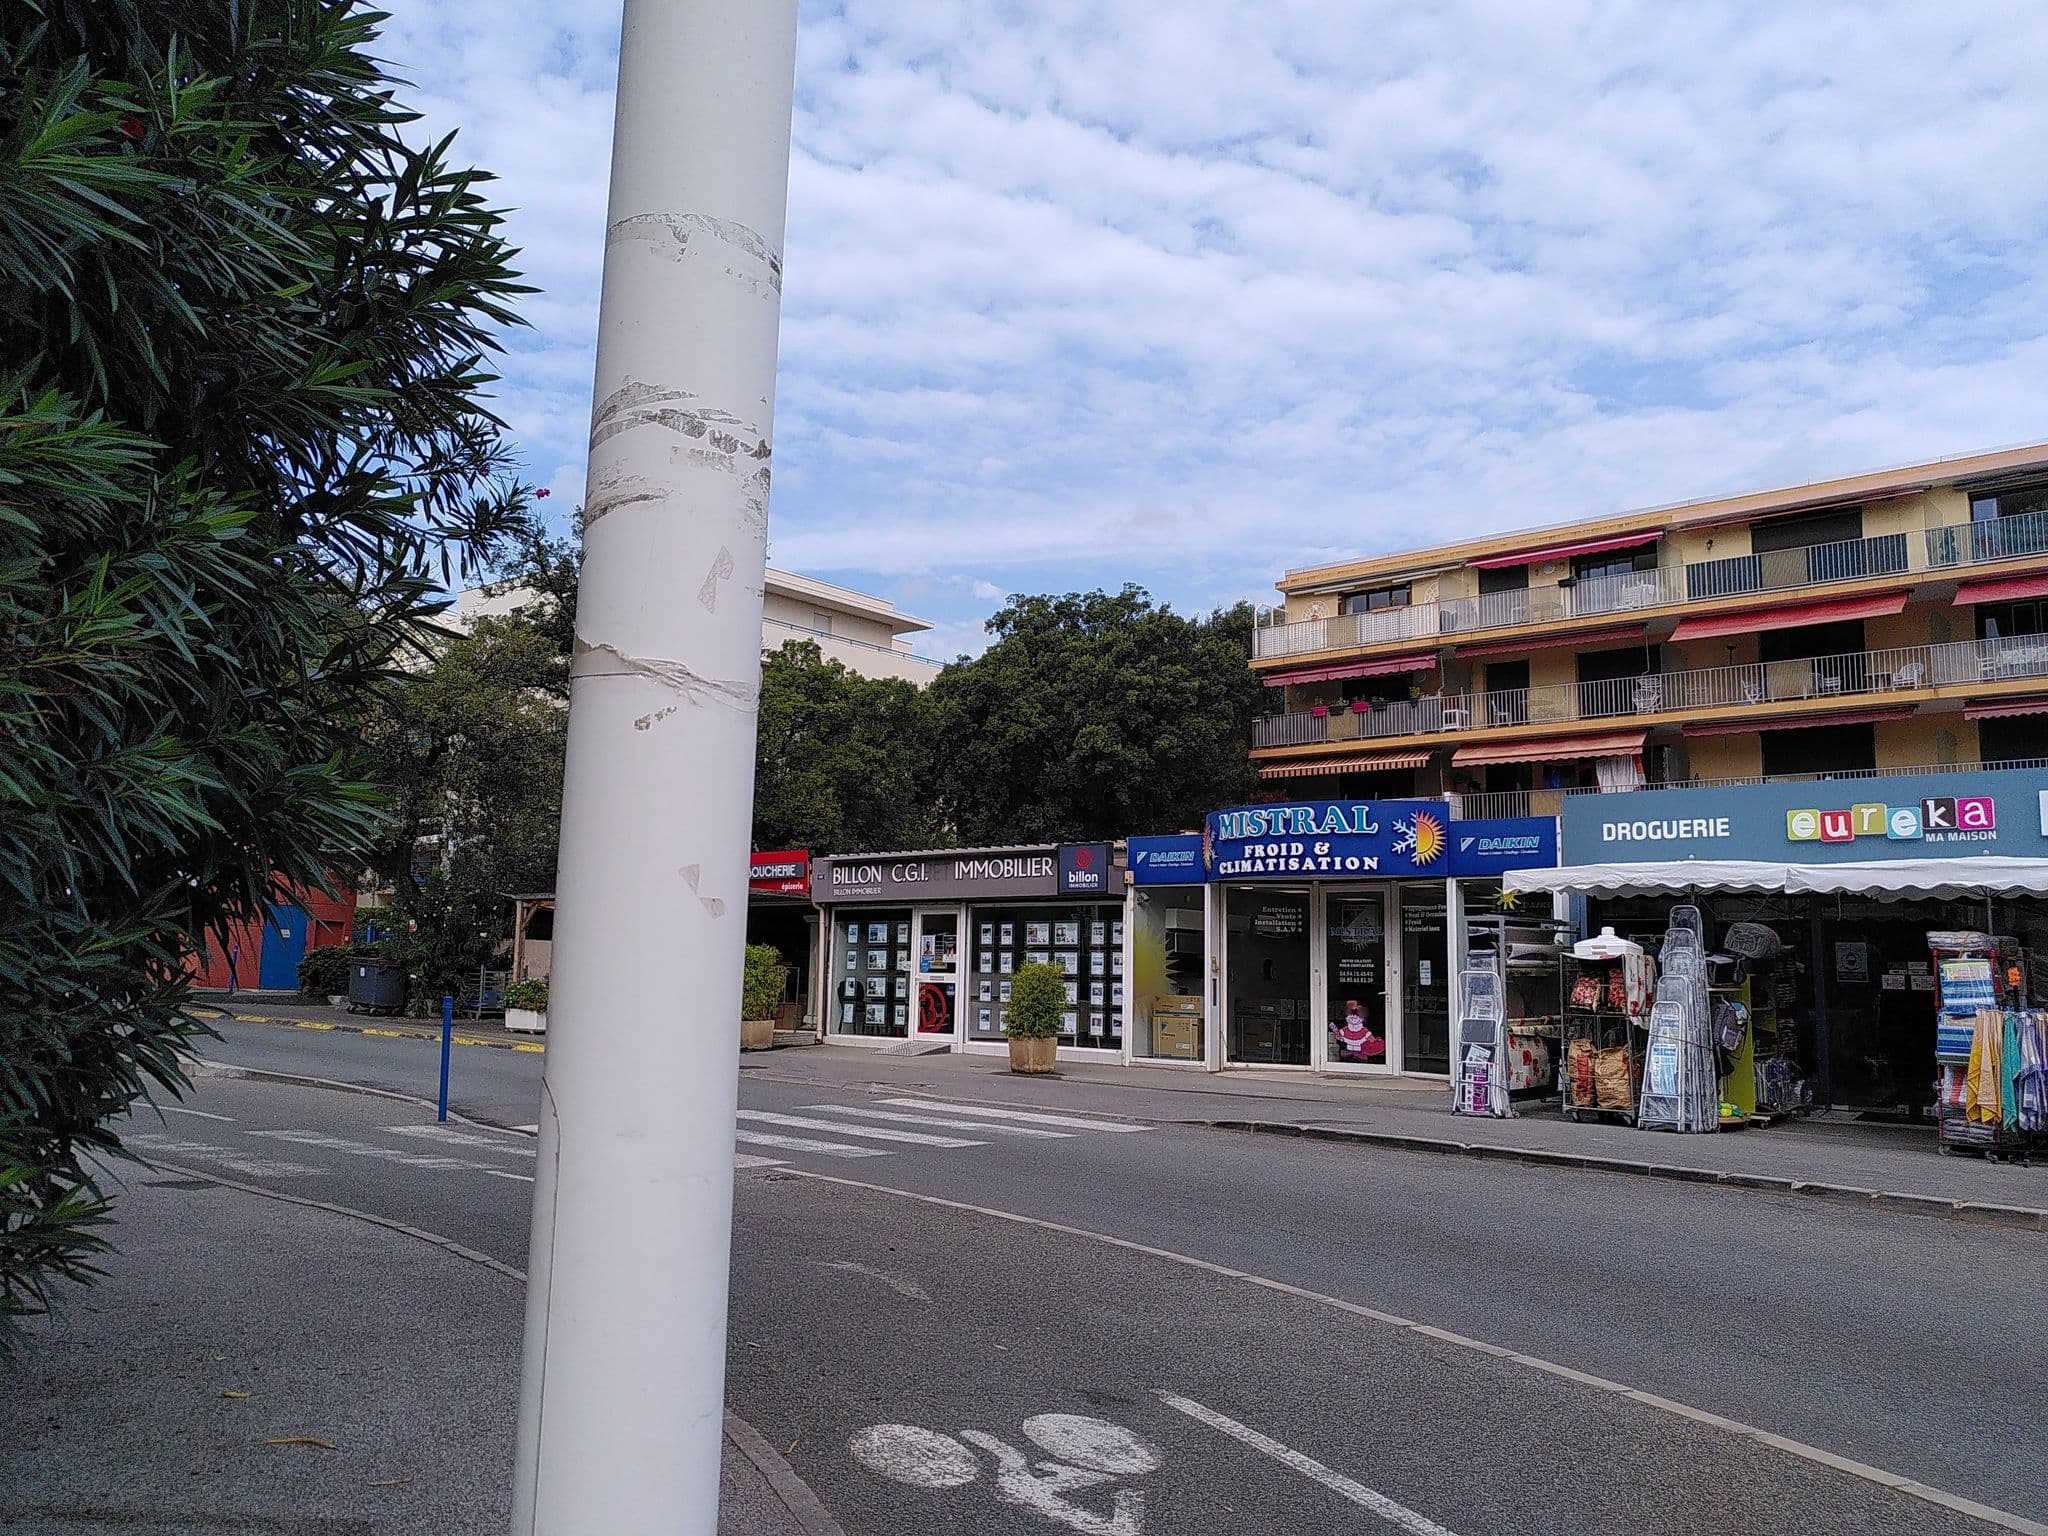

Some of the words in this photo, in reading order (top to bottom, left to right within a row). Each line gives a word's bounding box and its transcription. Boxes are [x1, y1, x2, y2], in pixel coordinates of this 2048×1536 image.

[1218, 805, 1379, 841] MISTRAL
[1791, 799, 1991, 838] eureka
[1602, 816, 1730, 842] DROGUERIE
[1925, 832, 1946, 842] MA
[1947, 829, 1998, 841] MAISON
[1243, 841, 1305, 859] FROID
[1313, 841, 1331, 856] &
[1478, 835, 1541, 850] DAIKIN
[1148, 850, 1195, 863] DAIKIN
[749, 864, 797, 879] OUCHERIE
[832, 865, 883, 886] BILLON
[891, 863, 930, 883] C.G.I.
[954, 857, 1055, 880] IMMOBILIER
[1219, 855, 1379, 875] CLIMATISATION
[1068, 871, 1099, 883] billon
[833, 887, 851, 897] BILLON
[851, 886, 882, 896] IMMOBILIER
[1262, 906, 1297, 914] Entretien
[1254, 919, 1297, 927] Installation
[1329, 926, 1384, 937] MISTRAL
